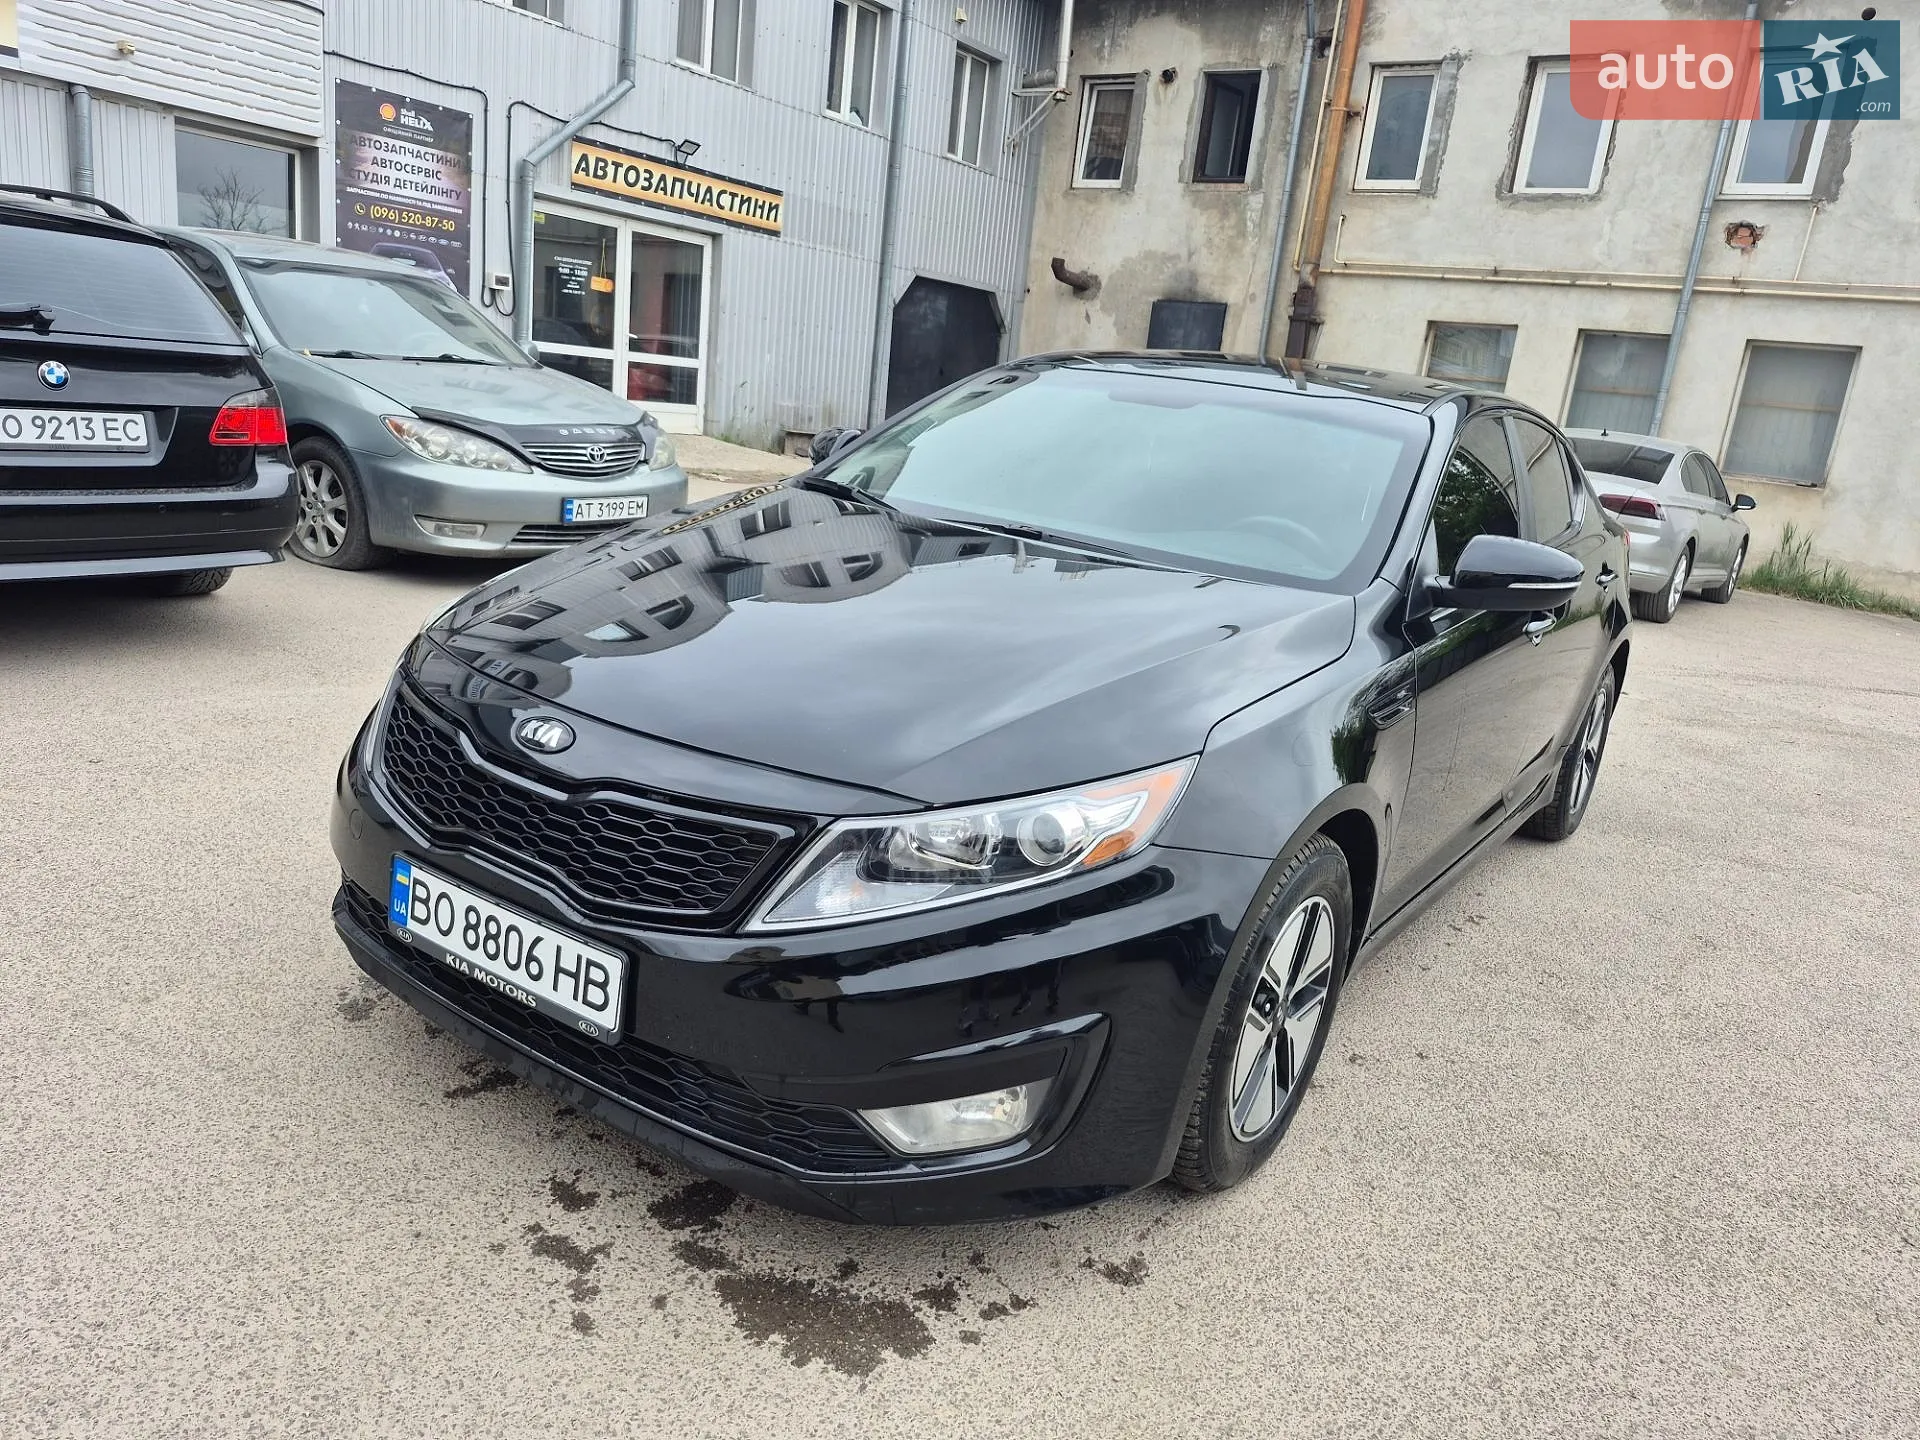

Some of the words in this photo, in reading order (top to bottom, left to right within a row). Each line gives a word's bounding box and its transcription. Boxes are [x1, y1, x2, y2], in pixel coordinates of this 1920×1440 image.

[400, 115, 434, 132] HELIX
[351, 135, 461, 169] АВТОЗАПЧАСТИНИ
[371, 156, 442, 180] АВТОСЕРВІС
[349, 169, 391, 186] СТУДІЯ
[393, 178, 462, 201] ДЕТЕЙЛІНГУ
[574, 152, 780, 223] АВТОЗАПЧАСТИНИ
[370, 205, 399, 223] (096)
[401, 212, 455, 232] 520-87-50
[31, 415, 96, 441] 9213
[102, 417, 141, 442] EC
[575, 503, 594, 519] AT
[597, 501, 625, 518] 3199
[627, 500, 644, 516] EM
[520, 719, 564, 748] KIA
[393, 897, 407, 917] UA
[399, 929, 410, 940] KIA
[410, 876, 456, 937] BO
[462, 904, 545, 982] 8806
[552, 944, 611, 1012] HB
[446, 952, 470, 975] KIA
[473, 967, 537, 1008] MOTORS
[581, 1022, 596, 1034] KIA
